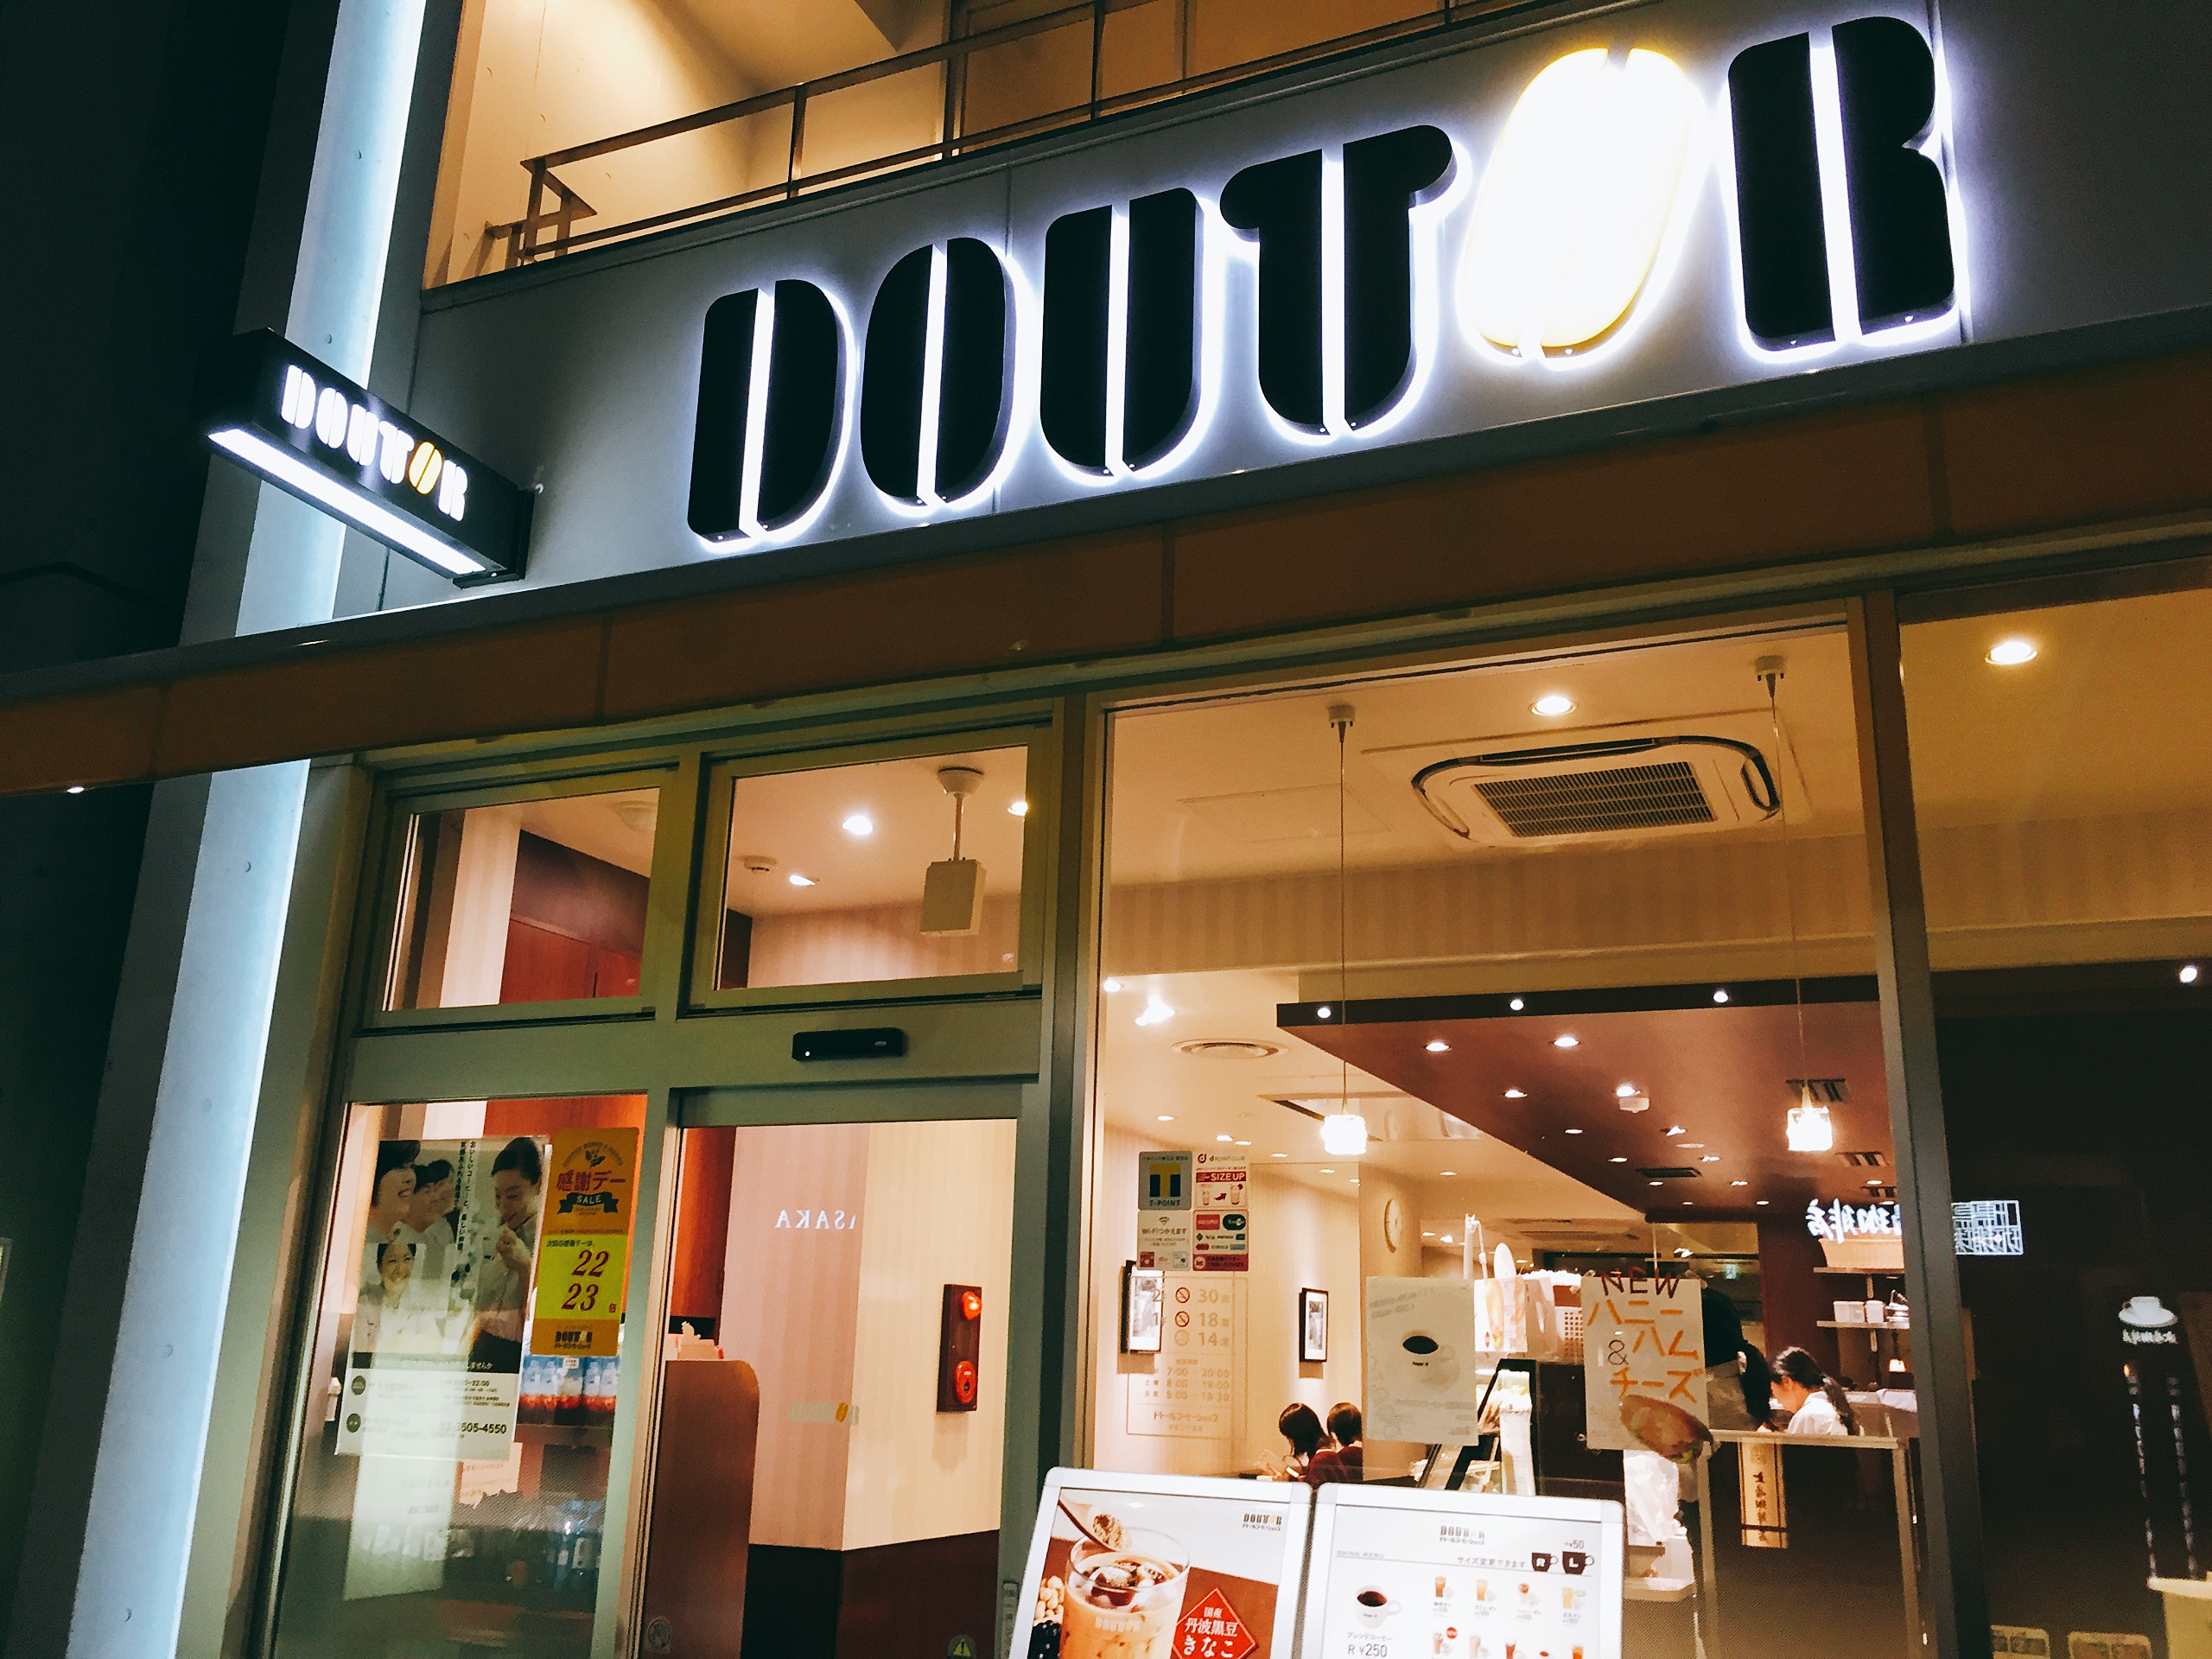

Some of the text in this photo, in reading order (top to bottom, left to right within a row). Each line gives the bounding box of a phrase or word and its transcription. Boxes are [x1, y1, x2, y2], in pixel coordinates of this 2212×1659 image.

[688, 16, 1961, 544] DOUTOR
[281, 364, 468, 522] DOUTOR
[556, 1169, 626, 1192] 感謝デー
[1211, 1173, 1232, 1181] SIZE
[1233, 1172, 1245, 1180] UP
[576, 1195, 601, 1205] SALE
[571, 1249, 610, 1278] 22
[562, 1282, 600, 1312] 23
[1599, 1272, 1681, 1299] NEW
[1586, 1300, 1684, 1329] ハニー
[1607, 1339, 1629, 1366] &
[1631, 1329, 1700, 1360] ハム
[1609, 1367, 1706, 1403] チーズ
[1568, 1557, 1579, 1568] L
[1204, 1606, 1223, 1618] 国産
[1185, 1618, 1238, 1637] 丹波黒豆
[1182, 1637, 1235, 1659] きなこ
[1347, 1642, 1388, 1657] R ¥250
